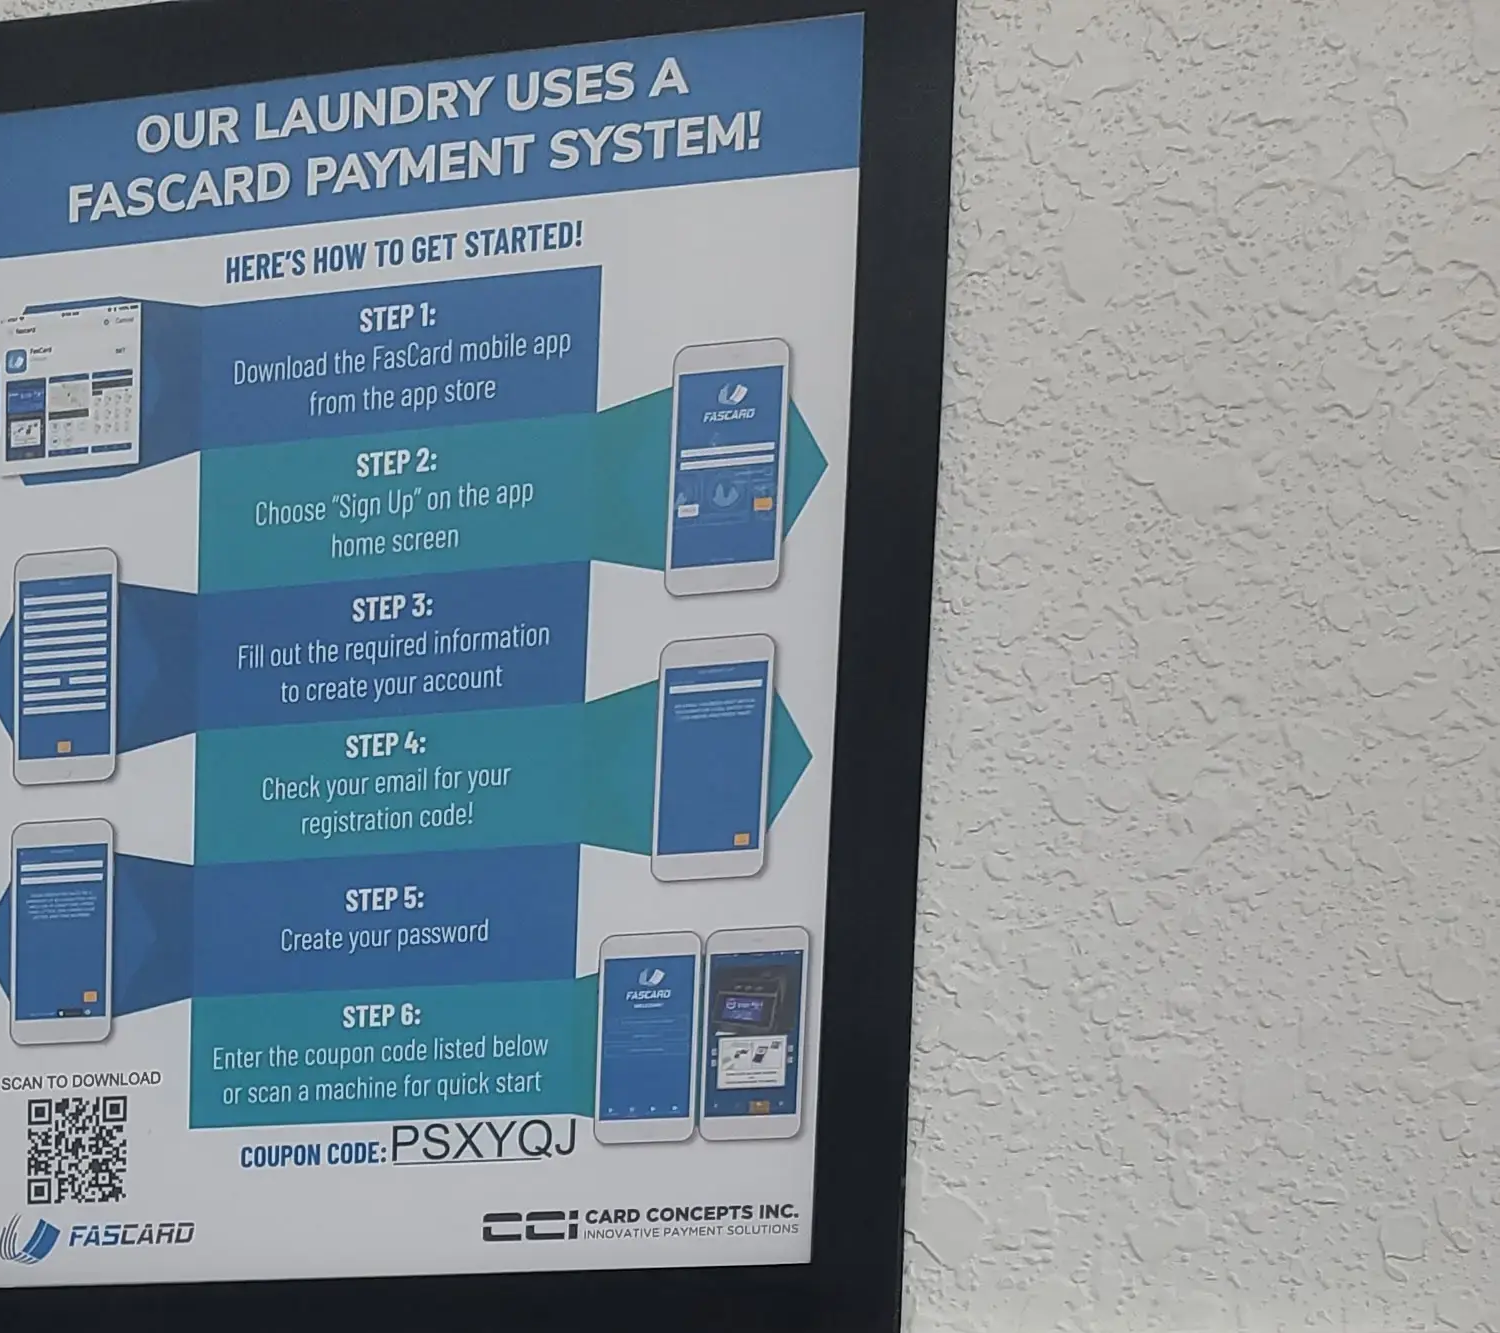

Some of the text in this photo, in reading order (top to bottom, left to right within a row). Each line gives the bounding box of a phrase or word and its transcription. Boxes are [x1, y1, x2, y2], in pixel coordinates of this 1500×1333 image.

[135, 56, 689, 155] OUR LAUNDRY USES A
[66, 111, 764, 224] FASCARD PAYMENT SYSTEM!
[313, 242, 367, 274] HOW
[374, 239, 404, 267] TO
[411, 233, 458, 264] GET
[464, 220, 583, 258] STARTED!
[359, 302, 436, 333] STEP 1:
[233, 331, 572, 385] Download the FasCard mobile app
[309, 378, 497, 416] from the app store
[703, 408, 756, 422] FASCARD
[356, 447, 437, 479] STEP 2:
[255, 501, 327, 526] Choose
[427, 490, 451, 511] on
[457, 483, 490, 507] the
[496, 481, 535, 509] app
[331, 527, 459, 558] home screen
[352, 593, 433, 623] STEP 3:
[237, 623, 550, 670] Fill out the required information
[280, 665, 503, 704] to create your account
[345, 731, 426, 759] STEP 4:
[262, 765, 512, 803] Check your email for your
[301, 802, 474, 839] registration code!
[345, 886, 425, 913] STEP 5:
[281, 919, 489, 955] Create your password
[625, 989, 671, 1001] FASCARD
[342, 1002, 422, 1029] STEP 6:
[212, 1033, 548, 1071] Enter the coupon code listed below
[1, 1071, 162, 1091] SCAN TO DOWNLOAD
[223, 1071, 542, 1105] or scan a machine for quick start
[240, 1118, 577, 1168] COUPON CODE: PSXYQJ
[585, 1203, 799, 1225] CARD CONCEPTS INC.
[69, 1222, 195, 1247] FASCARD
[583, 1223, 799, 1241] INNOVATIVE PAYMENT SOLUTIONS
